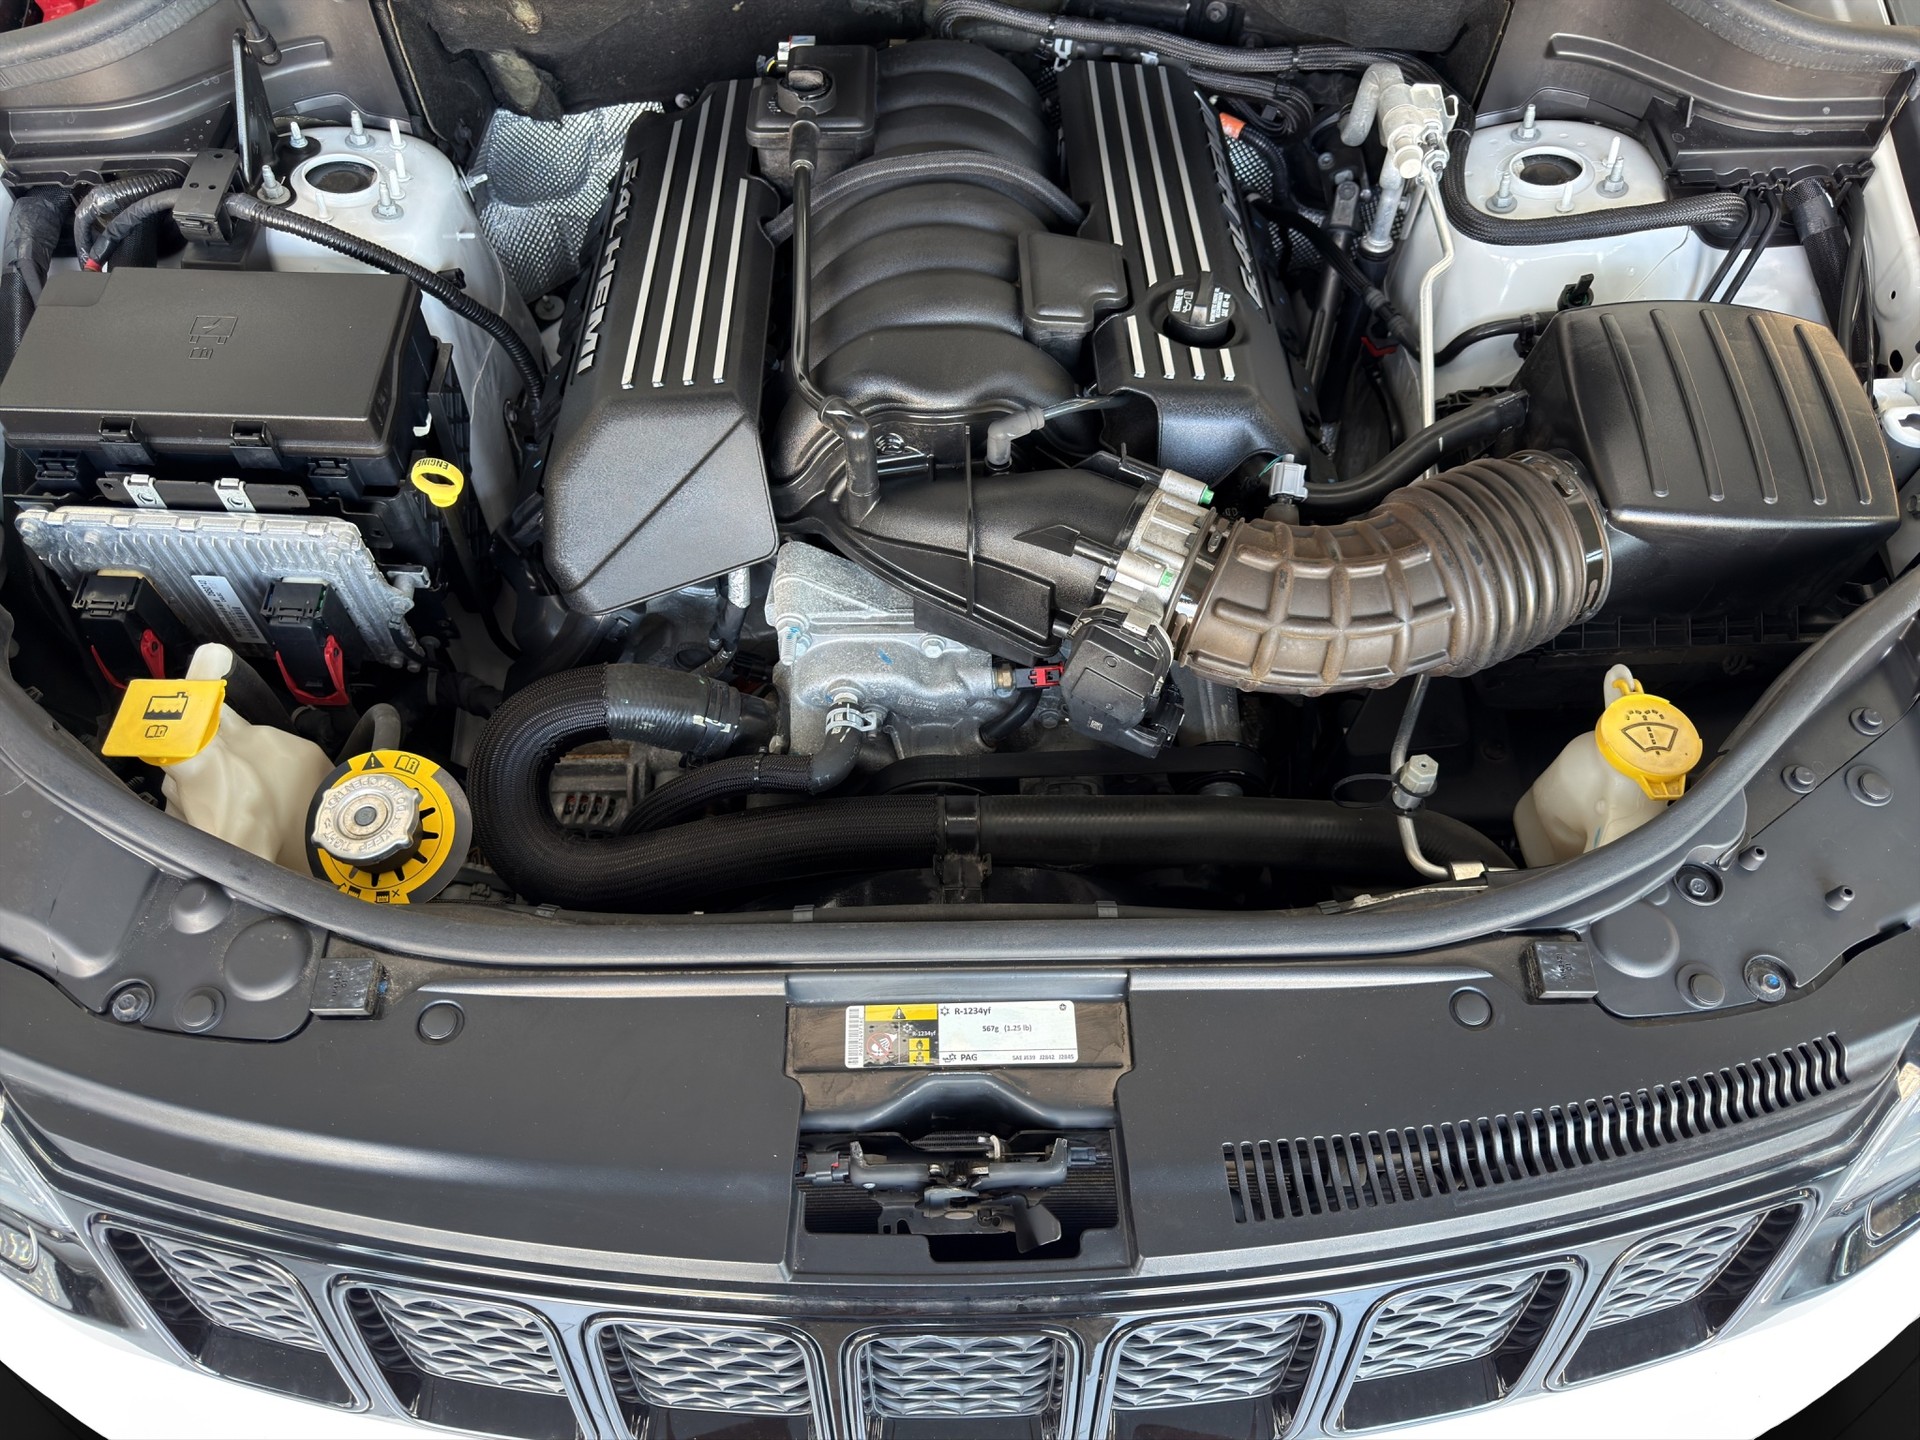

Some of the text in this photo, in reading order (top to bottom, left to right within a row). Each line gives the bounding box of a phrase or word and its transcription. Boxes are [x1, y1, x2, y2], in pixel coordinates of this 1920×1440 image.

[577, 236, 621, 374] HEMI
[417, 459, 449, 470] ENGINE
[358, 829, 393, 852] KEEP
[954, 1006, 991, 1016] R-1234yf
[982, 1024, 1032, 1033] 567g (1.25 lb)
